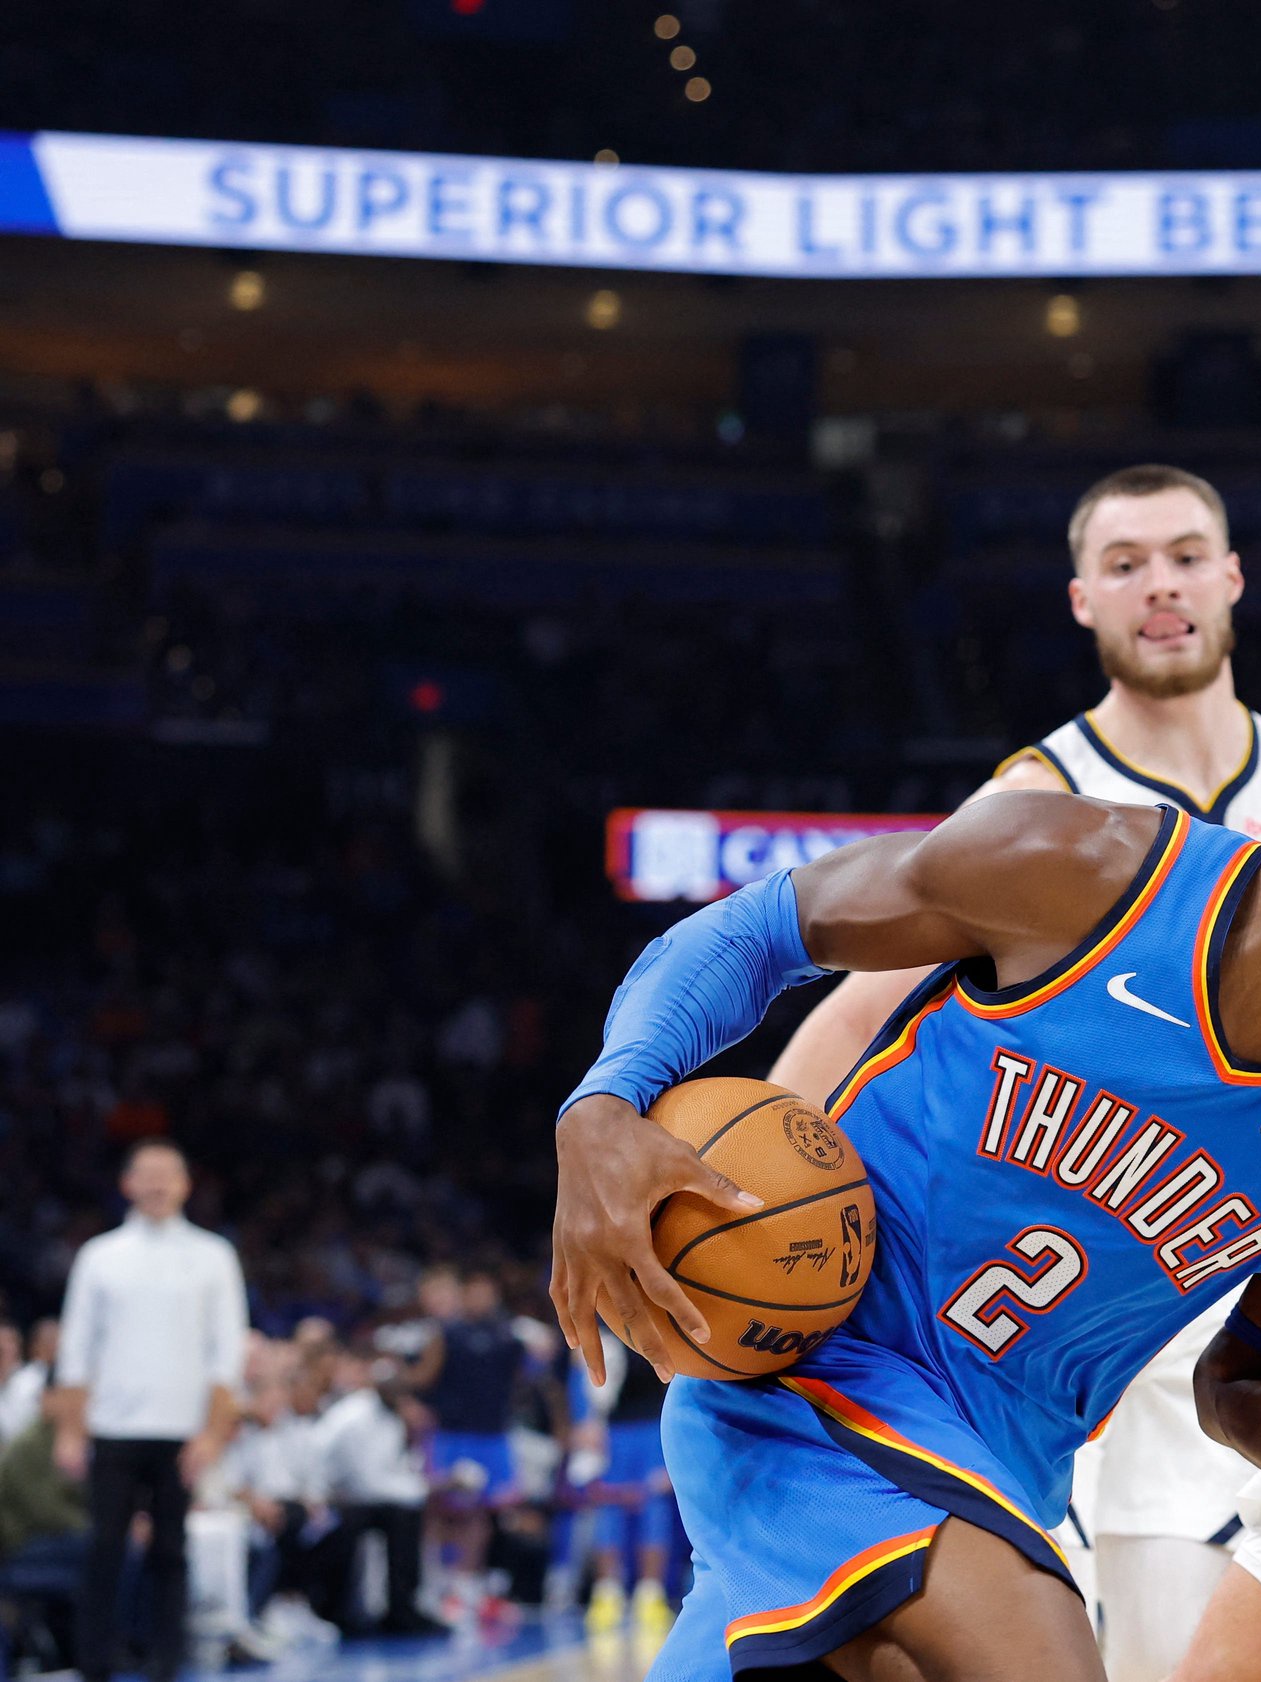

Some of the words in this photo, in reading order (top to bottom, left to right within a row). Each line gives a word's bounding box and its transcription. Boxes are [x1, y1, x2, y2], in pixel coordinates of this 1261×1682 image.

[206, 150, 746, 257] SUPERIOR
[795, 182, 1108, 264] LIGHT
[936, 1224, 1089, 1363] 2
